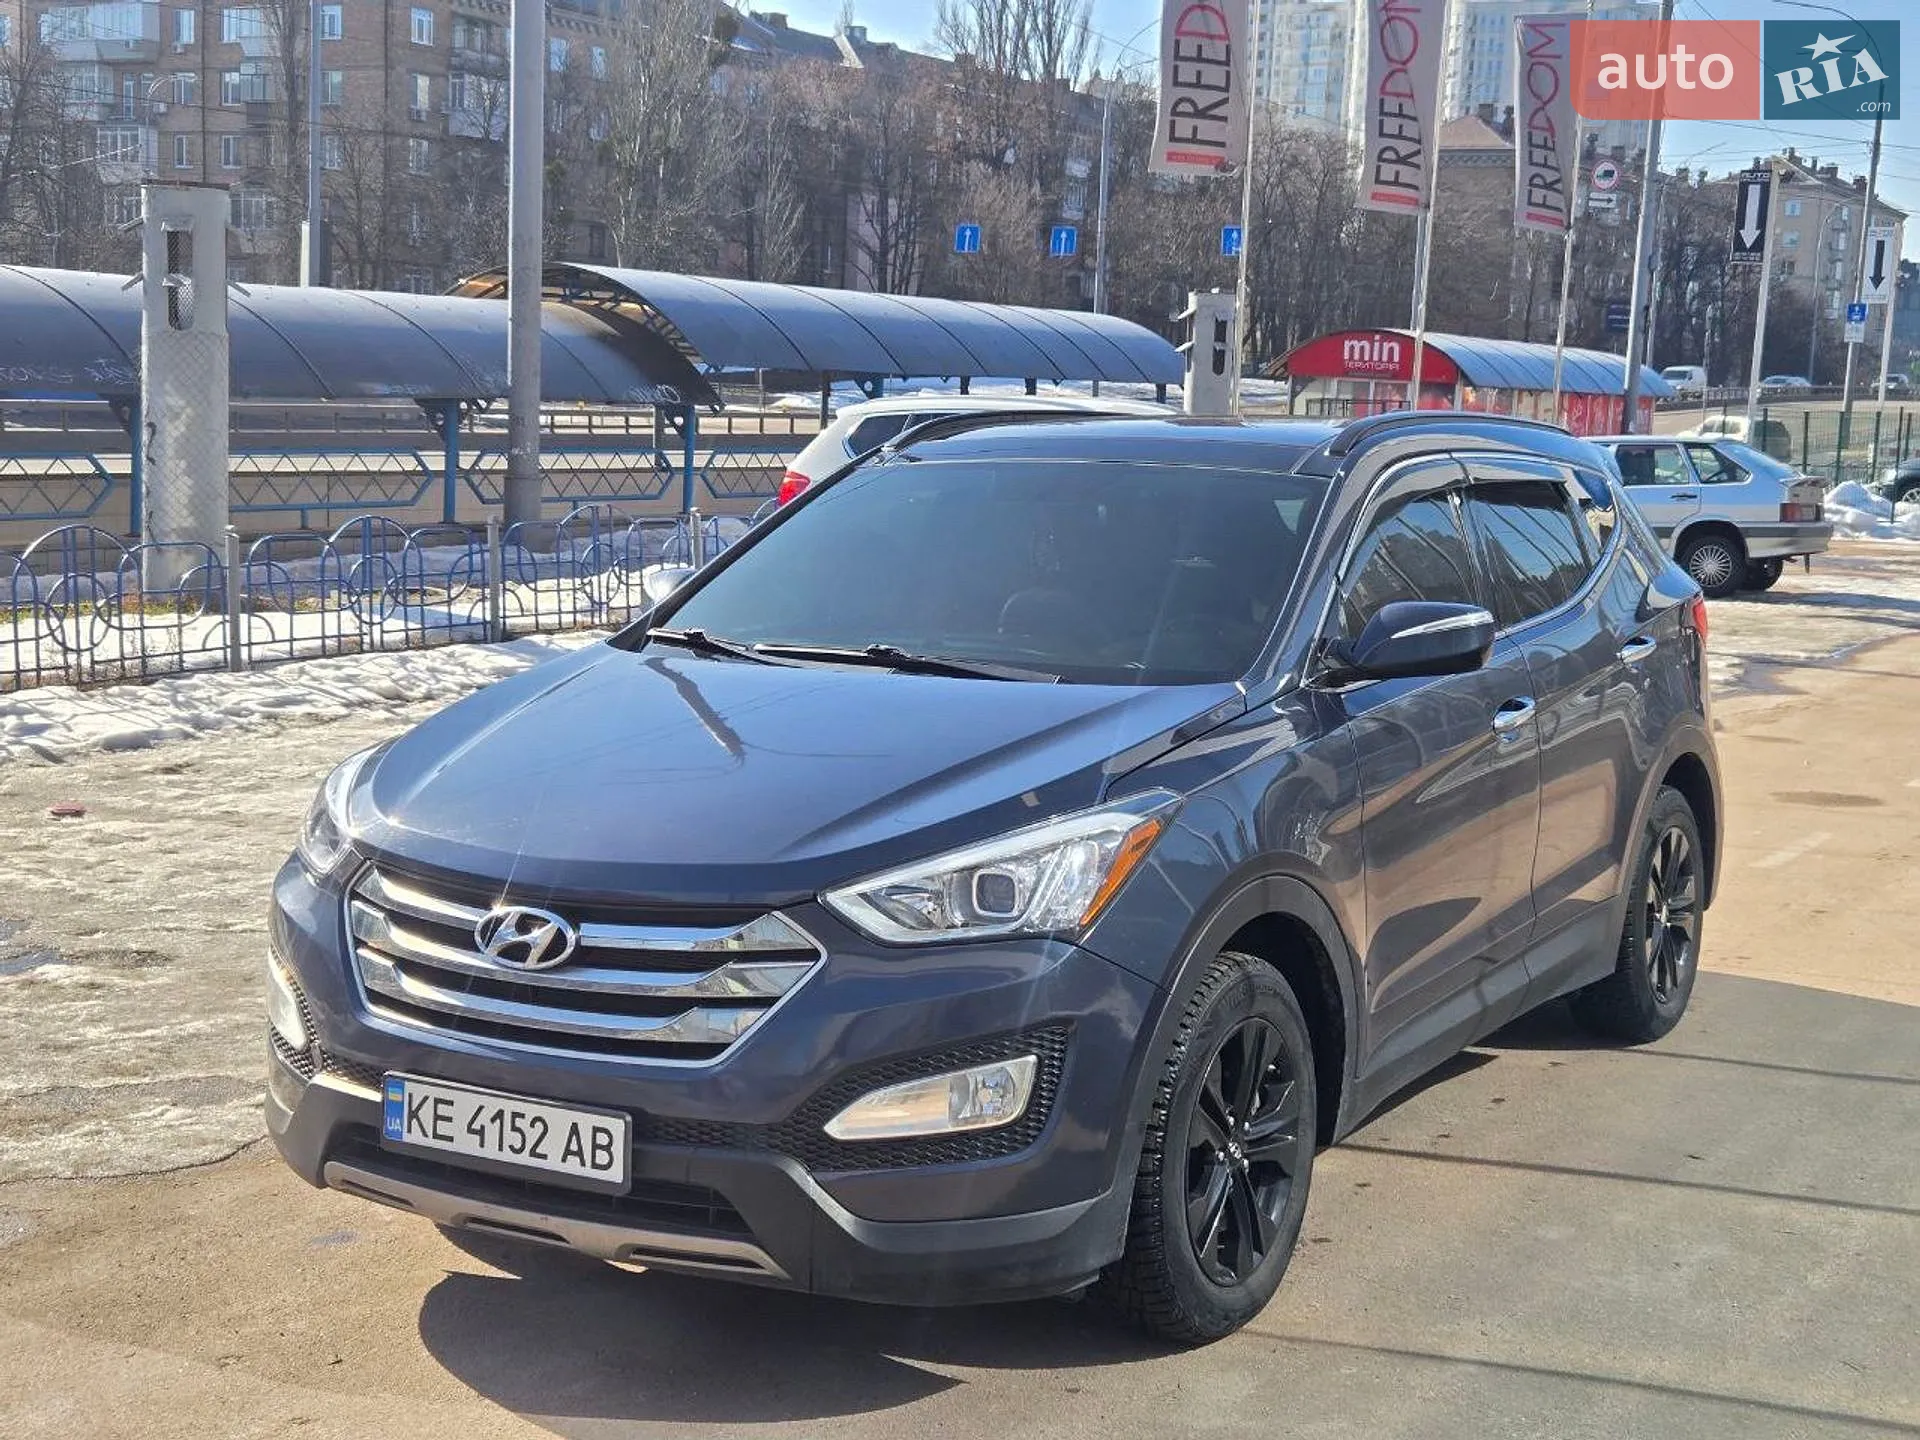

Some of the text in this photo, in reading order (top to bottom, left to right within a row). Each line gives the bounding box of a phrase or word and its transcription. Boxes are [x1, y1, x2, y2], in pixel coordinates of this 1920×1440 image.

[1523, 21, 1567, 214] FREEDOM
[1343, 334, 1400, 363] min
[386, 1115, 402, 1133] UA
[406, 1091, 615, 1172] KE 4152 AB
